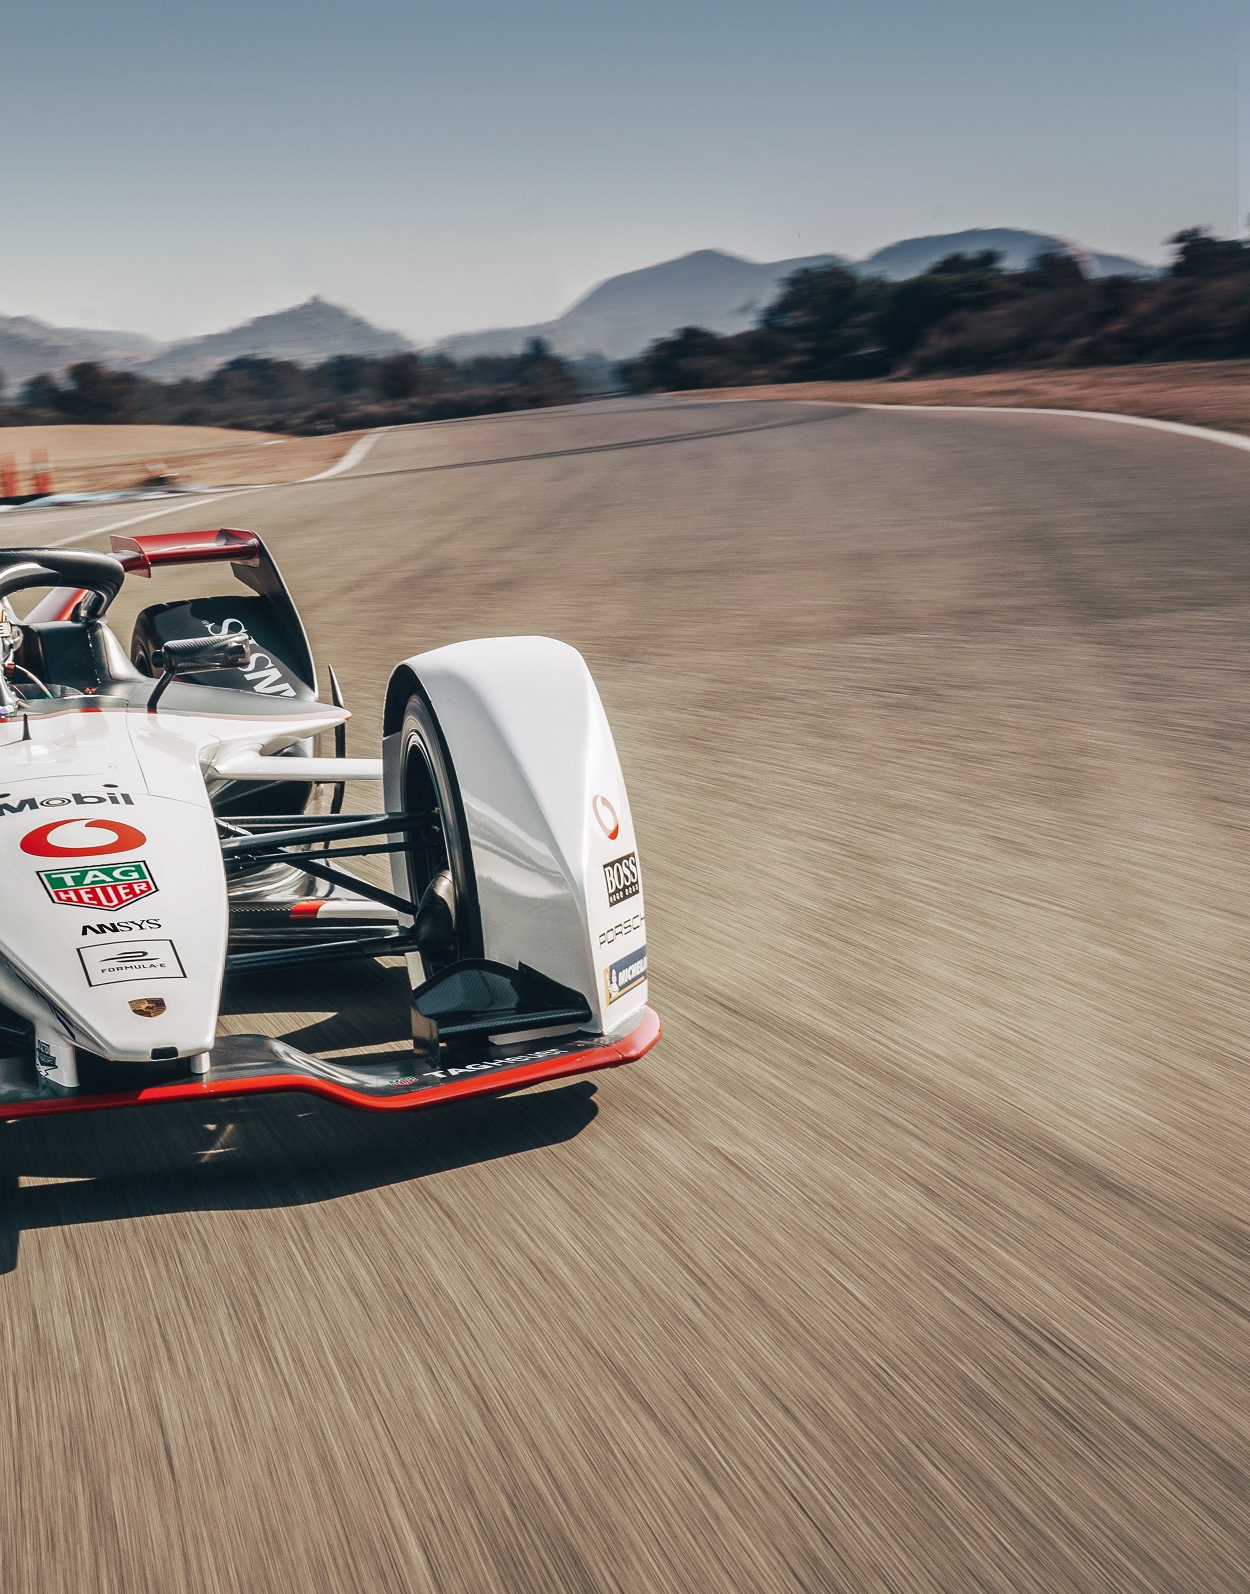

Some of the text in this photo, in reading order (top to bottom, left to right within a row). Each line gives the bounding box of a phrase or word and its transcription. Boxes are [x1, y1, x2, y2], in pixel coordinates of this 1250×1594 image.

[50, 866, 141, 887] TAG
[605, 856, 638, 894] BOSS
[58, 881, 150, 908] HEUER
[81, 918, 162, 936] ANSYS
[422, 1063, 494, 1079] TAG
